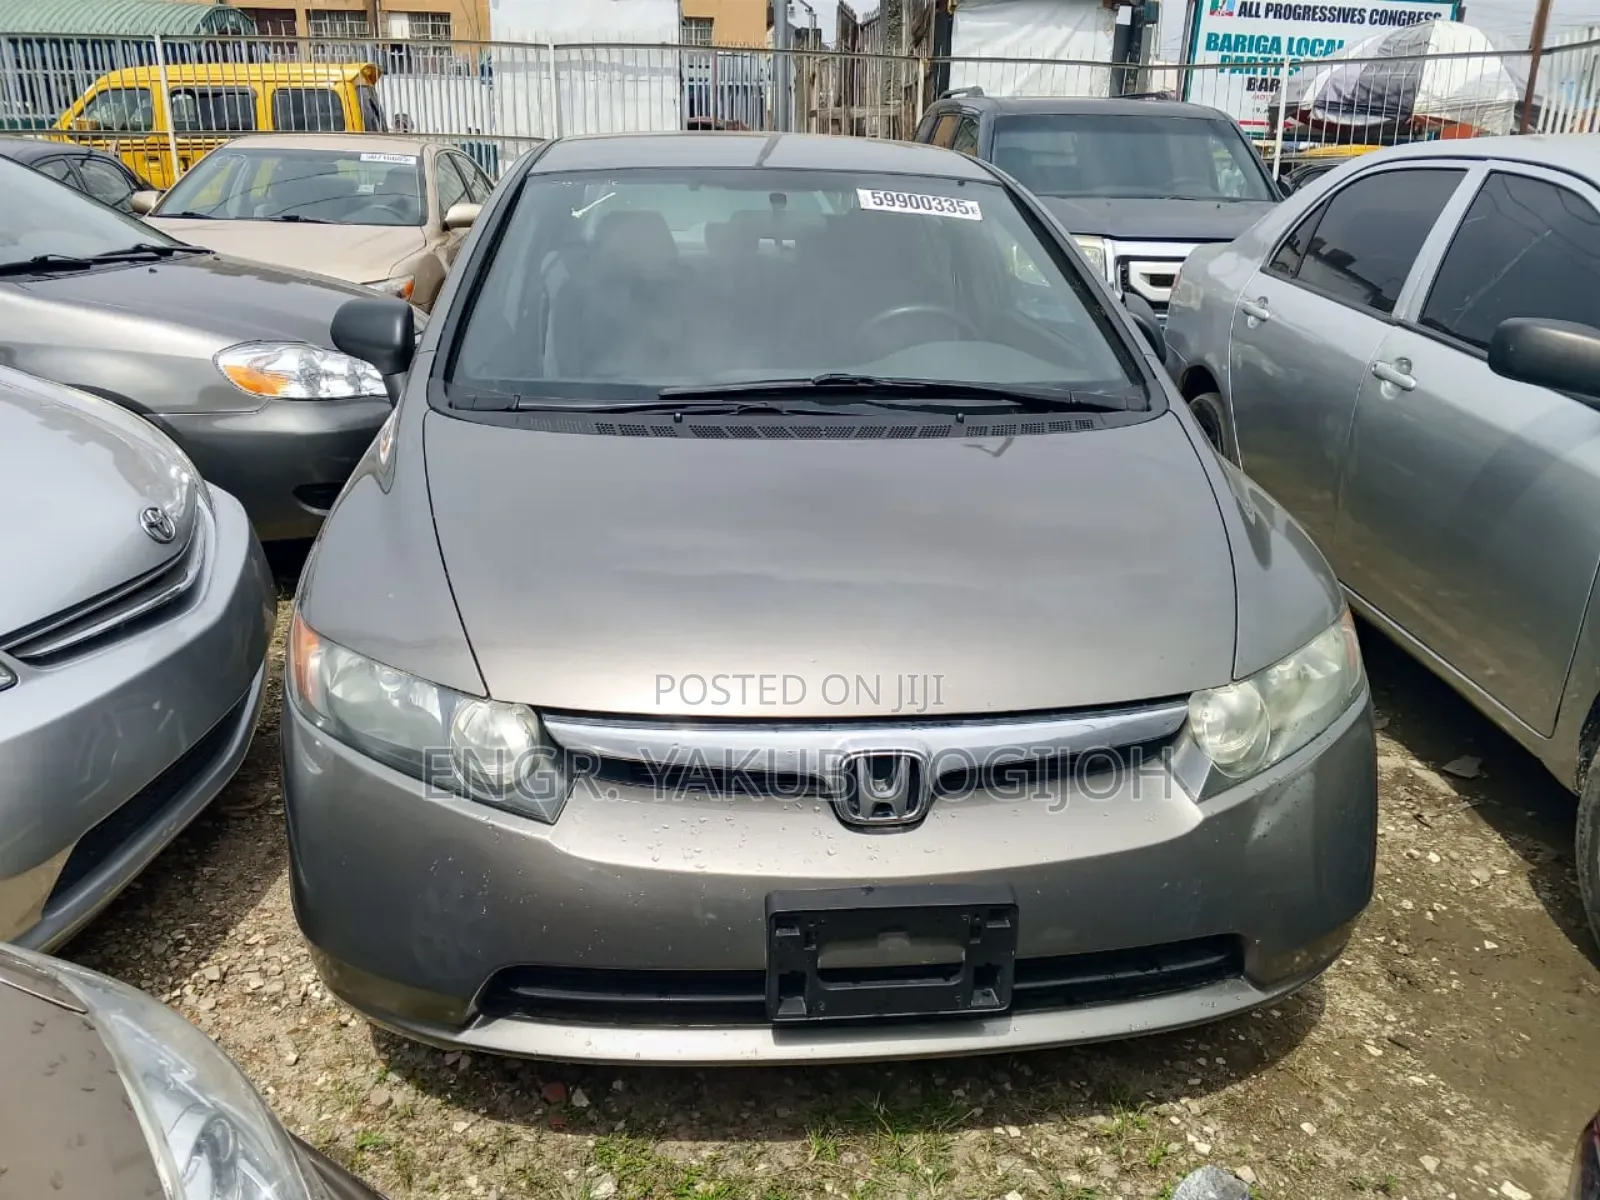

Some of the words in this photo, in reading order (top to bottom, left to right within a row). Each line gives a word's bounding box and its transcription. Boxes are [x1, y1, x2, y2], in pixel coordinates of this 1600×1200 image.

[1238, 1, 1262, 18] ALL
[1265, 3, 1367, 25] PROGRESSIVES
[1205, 32, 1282, 55] BARIGA
[1219, 54, 1285, 76] PARTY
